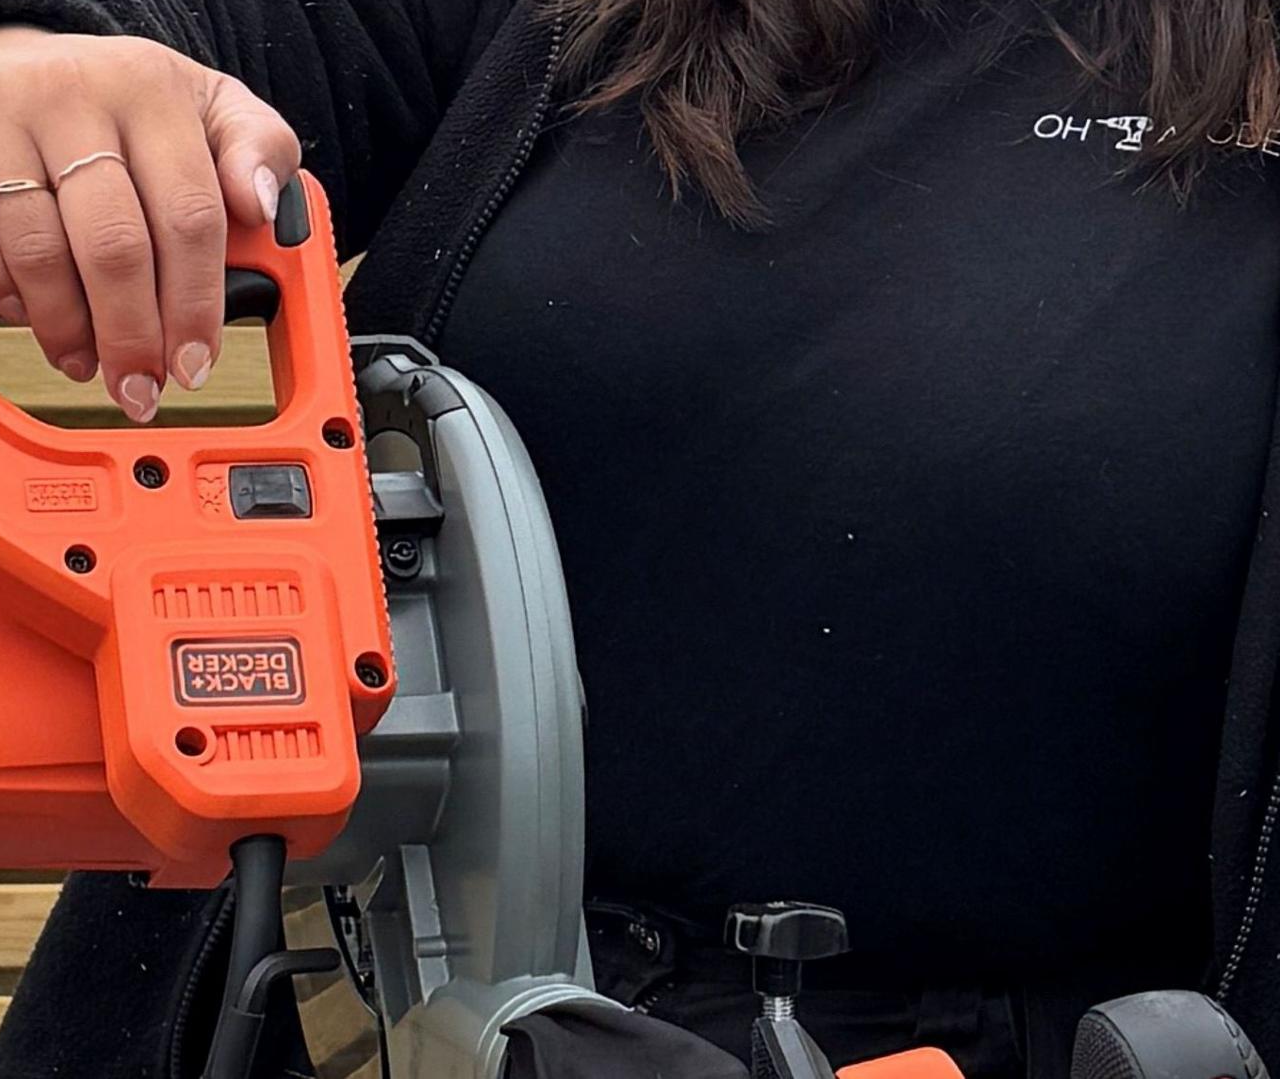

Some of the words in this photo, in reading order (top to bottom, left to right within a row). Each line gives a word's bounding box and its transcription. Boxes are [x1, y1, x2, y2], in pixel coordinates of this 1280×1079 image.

[1033, 113, 1092, 142] OH
[187, 653, 287, 673] DECKER
[191, 672, 290, 692] BLACK+
